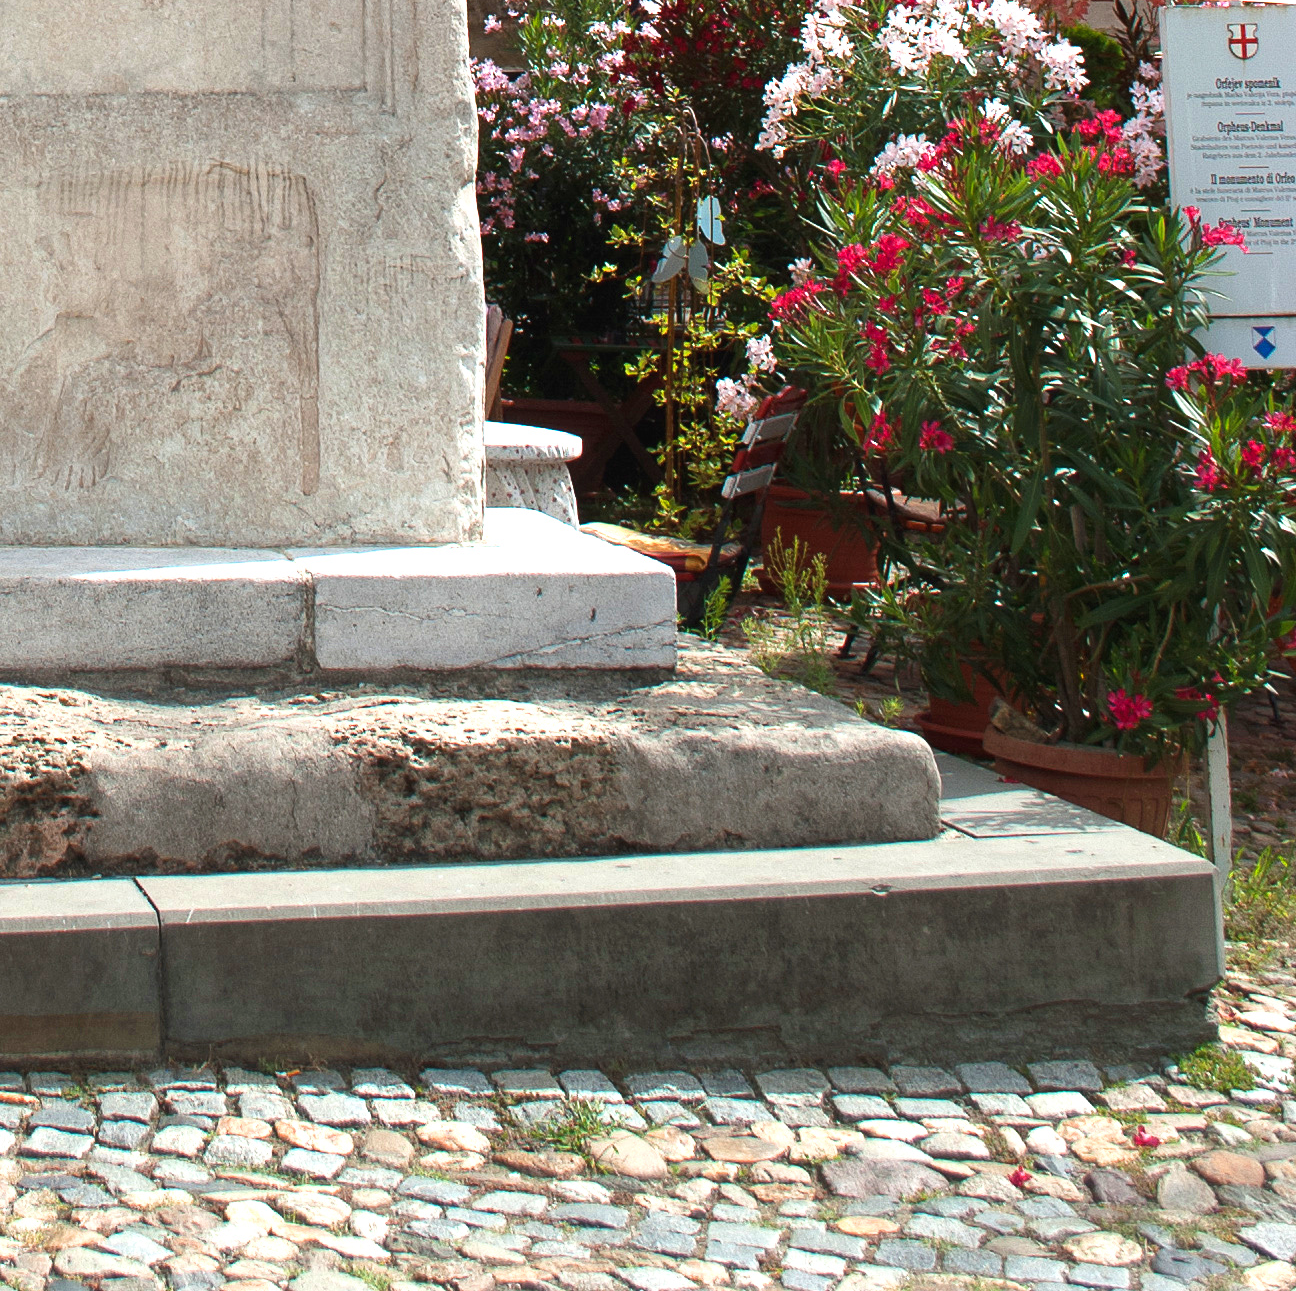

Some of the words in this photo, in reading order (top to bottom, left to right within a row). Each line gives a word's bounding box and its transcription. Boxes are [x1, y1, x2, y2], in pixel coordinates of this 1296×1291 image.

[1244, 77, 1281, 92] spomenik
[1217, 120, 1284, 136] Orpheus-Denkmal
[1219, 175, 1264, 185] monumento
[1266, 173, 1273, 184] di
[1253, 217, 1294, 228] Monument
